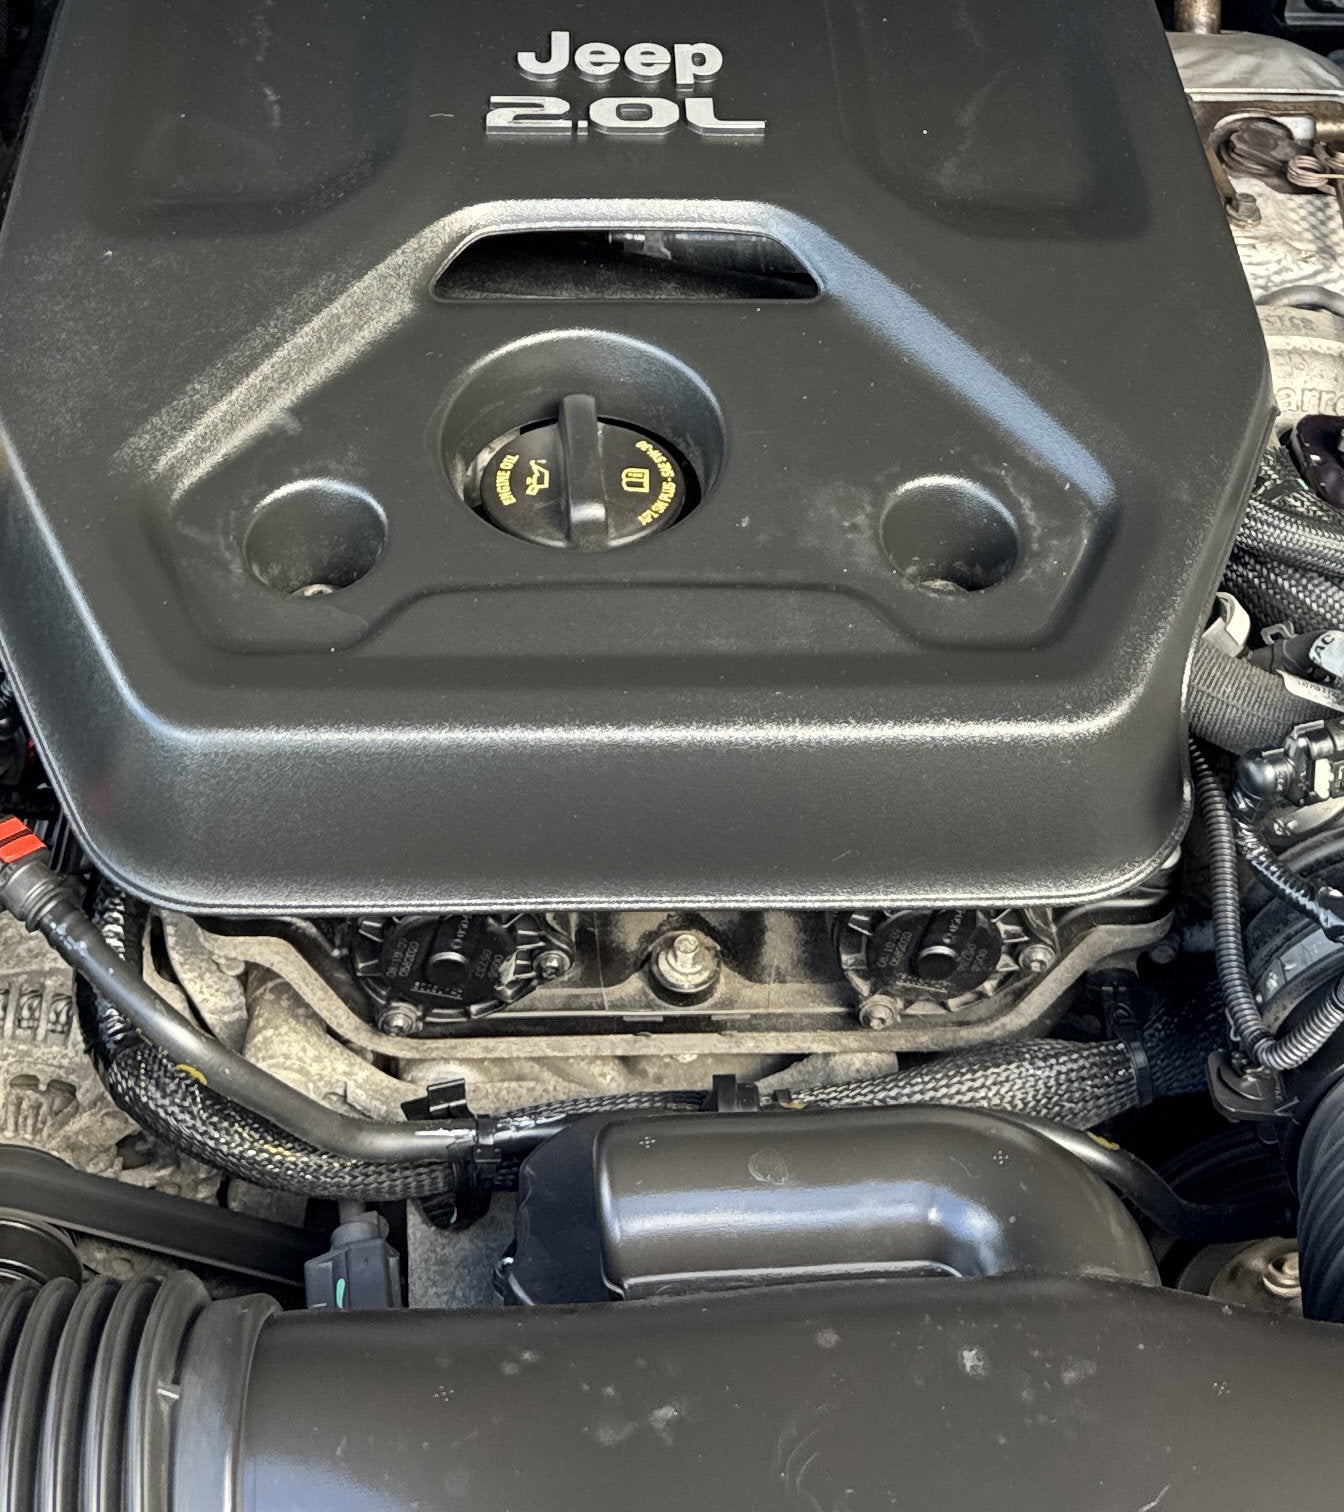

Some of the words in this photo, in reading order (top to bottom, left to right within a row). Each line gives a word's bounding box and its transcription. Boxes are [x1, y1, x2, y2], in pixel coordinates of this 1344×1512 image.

[517, 30, 724, 90] Jeep
[486, 96, 767, 136] 2.0L
[499, 454, 520, 470] OIL
[495, 470, 517, 506] ENGINE
[657, 481, 677, 503] PLUS
